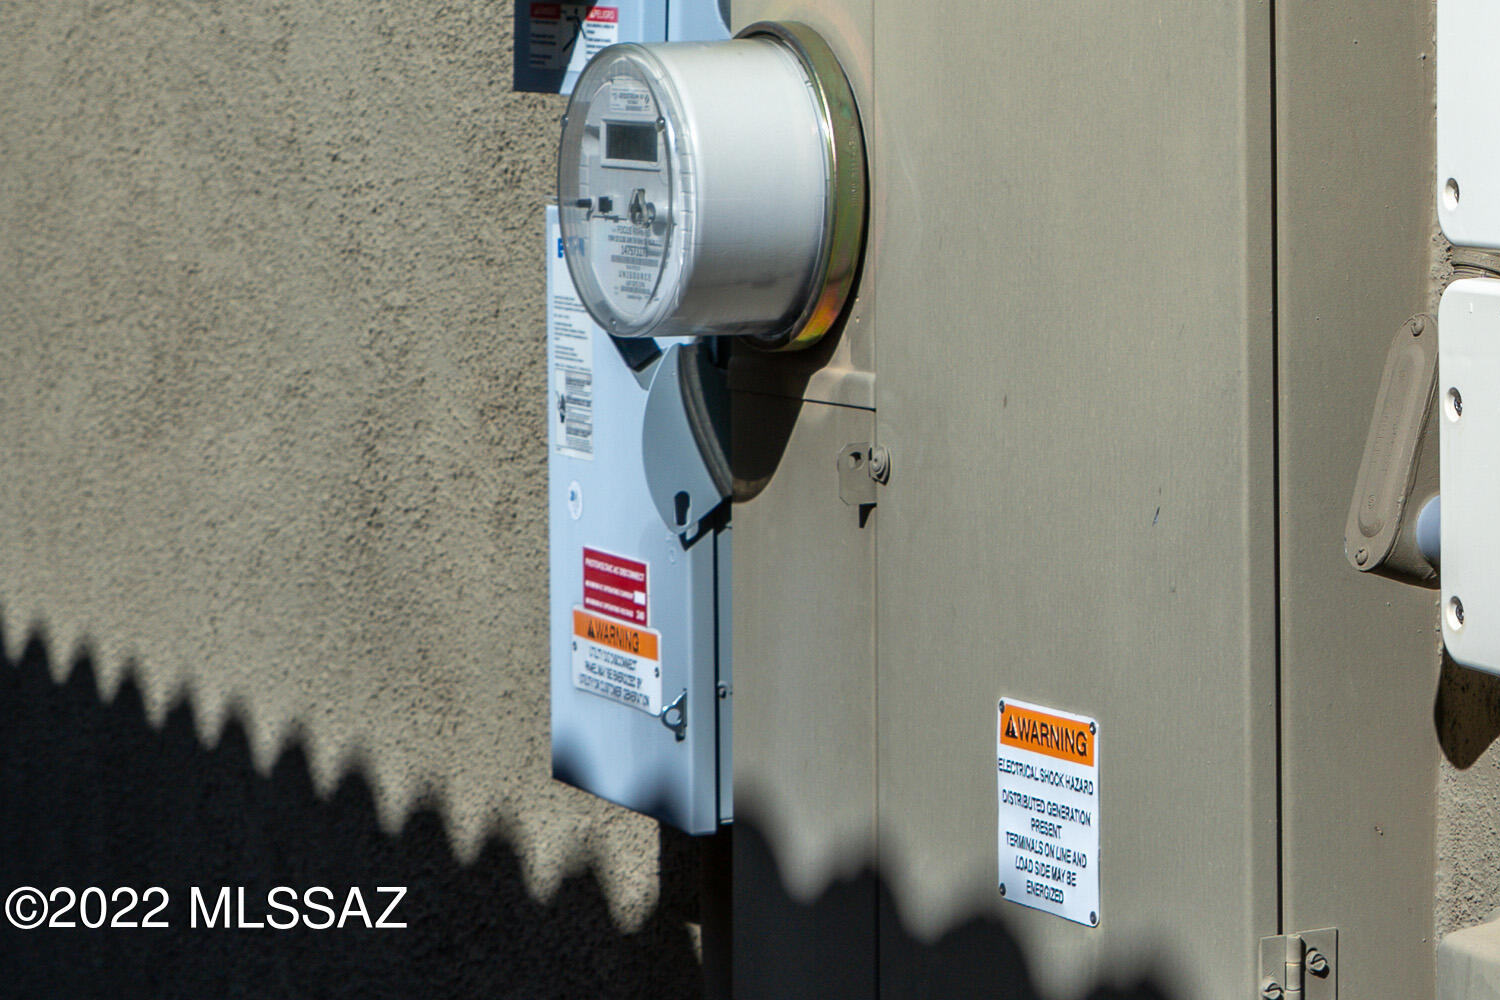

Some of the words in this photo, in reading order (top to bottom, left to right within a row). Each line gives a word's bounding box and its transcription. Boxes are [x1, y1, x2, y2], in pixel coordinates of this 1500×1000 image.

[594, 622, 639, 652] WARNING
[1017, 716, 1087, 757] WARNING
[998, 758, 1039, 782] ELECTRICAL
[1040, 767, 1065, 788] SHOCK
[1065, 775, 1093, 795] HAZARD
[1002, 789, 1045, 813] DISTRIBUTED
[1046, 801, 1091, 827] GENERATION
[1030, 818, 1062, 839] PRESENT
[1006, 832, 1044, 856] TERMINALS
[1044, 844, 1055, 856] ON
[1055, 847, 1072, 864] LINE
[1073, 852, 1087, 868] AND
[1015, 855, 1034, 873] LOAD
[1034, 863, 1051, 878] SIDE
[1051, 867, 1065, 884] MAY
[1066, 872, 1076, 887] BE
[1026, 880, 1064, 904] ENERGIZED
